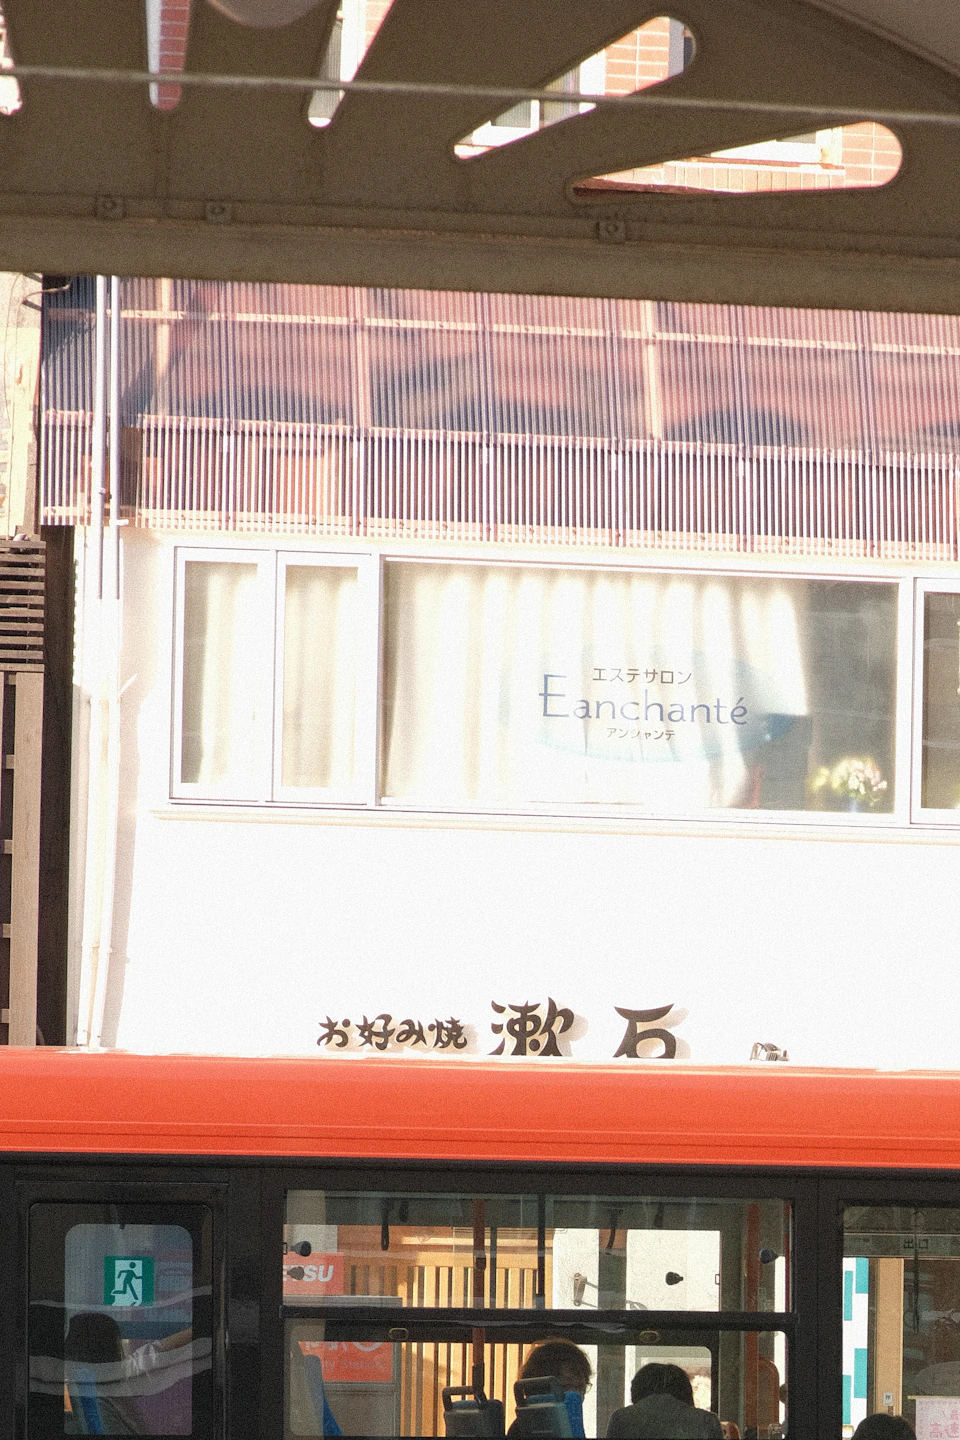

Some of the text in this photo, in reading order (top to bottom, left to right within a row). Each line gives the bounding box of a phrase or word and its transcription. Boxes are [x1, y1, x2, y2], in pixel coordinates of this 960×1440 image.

[592, 667, 692, 685] エステサロン
[539, 673, 748, 726] Eanchanté
[316, 1013, 468, 1050] お好み焼
